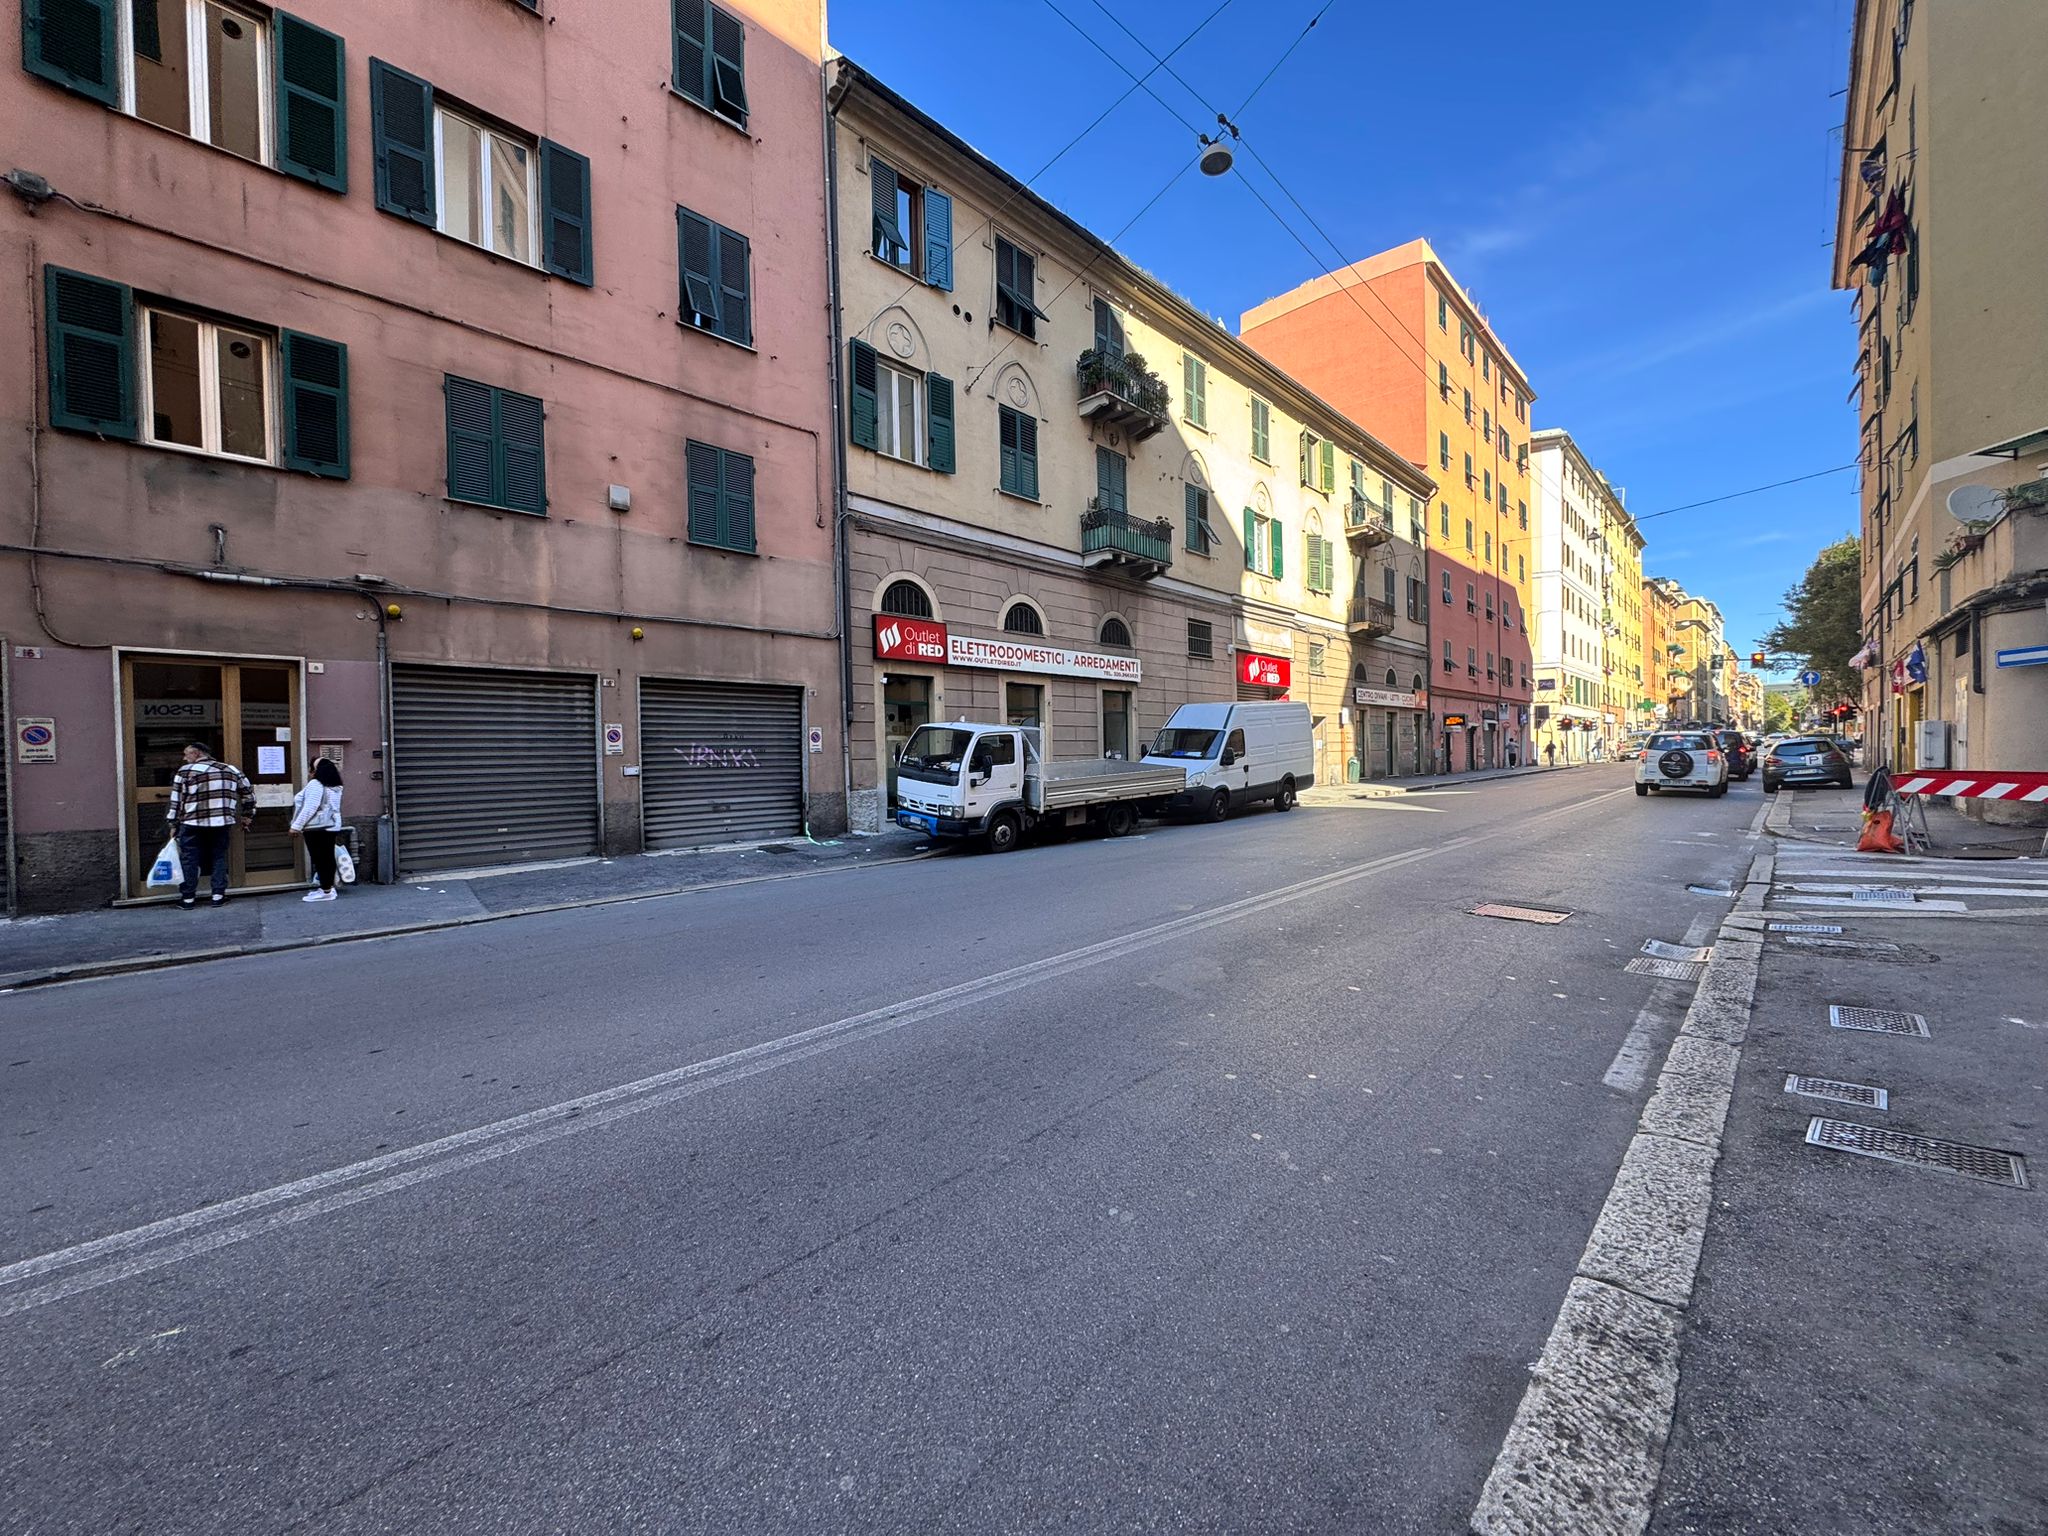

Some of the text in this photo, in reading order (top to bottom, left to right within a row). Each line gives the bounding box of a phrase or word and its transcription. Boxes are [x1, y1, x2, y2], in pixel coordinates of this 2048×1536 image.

[904, 627, 940, 643] Outlet
[905, 642, 944, 657] di RED
[952, 639, 1065, 665] ELETTRODOMESTICI
[1073, 655, 1139, 673] ARREDAMENTI
[952, 655, 1021, 667] WWW.OUTLETDIRED.IT
[1260, 660, 1278, 673] Outlet
[1260, 672, 1266, 682] di
[1809, 756, 1819, 764] P
